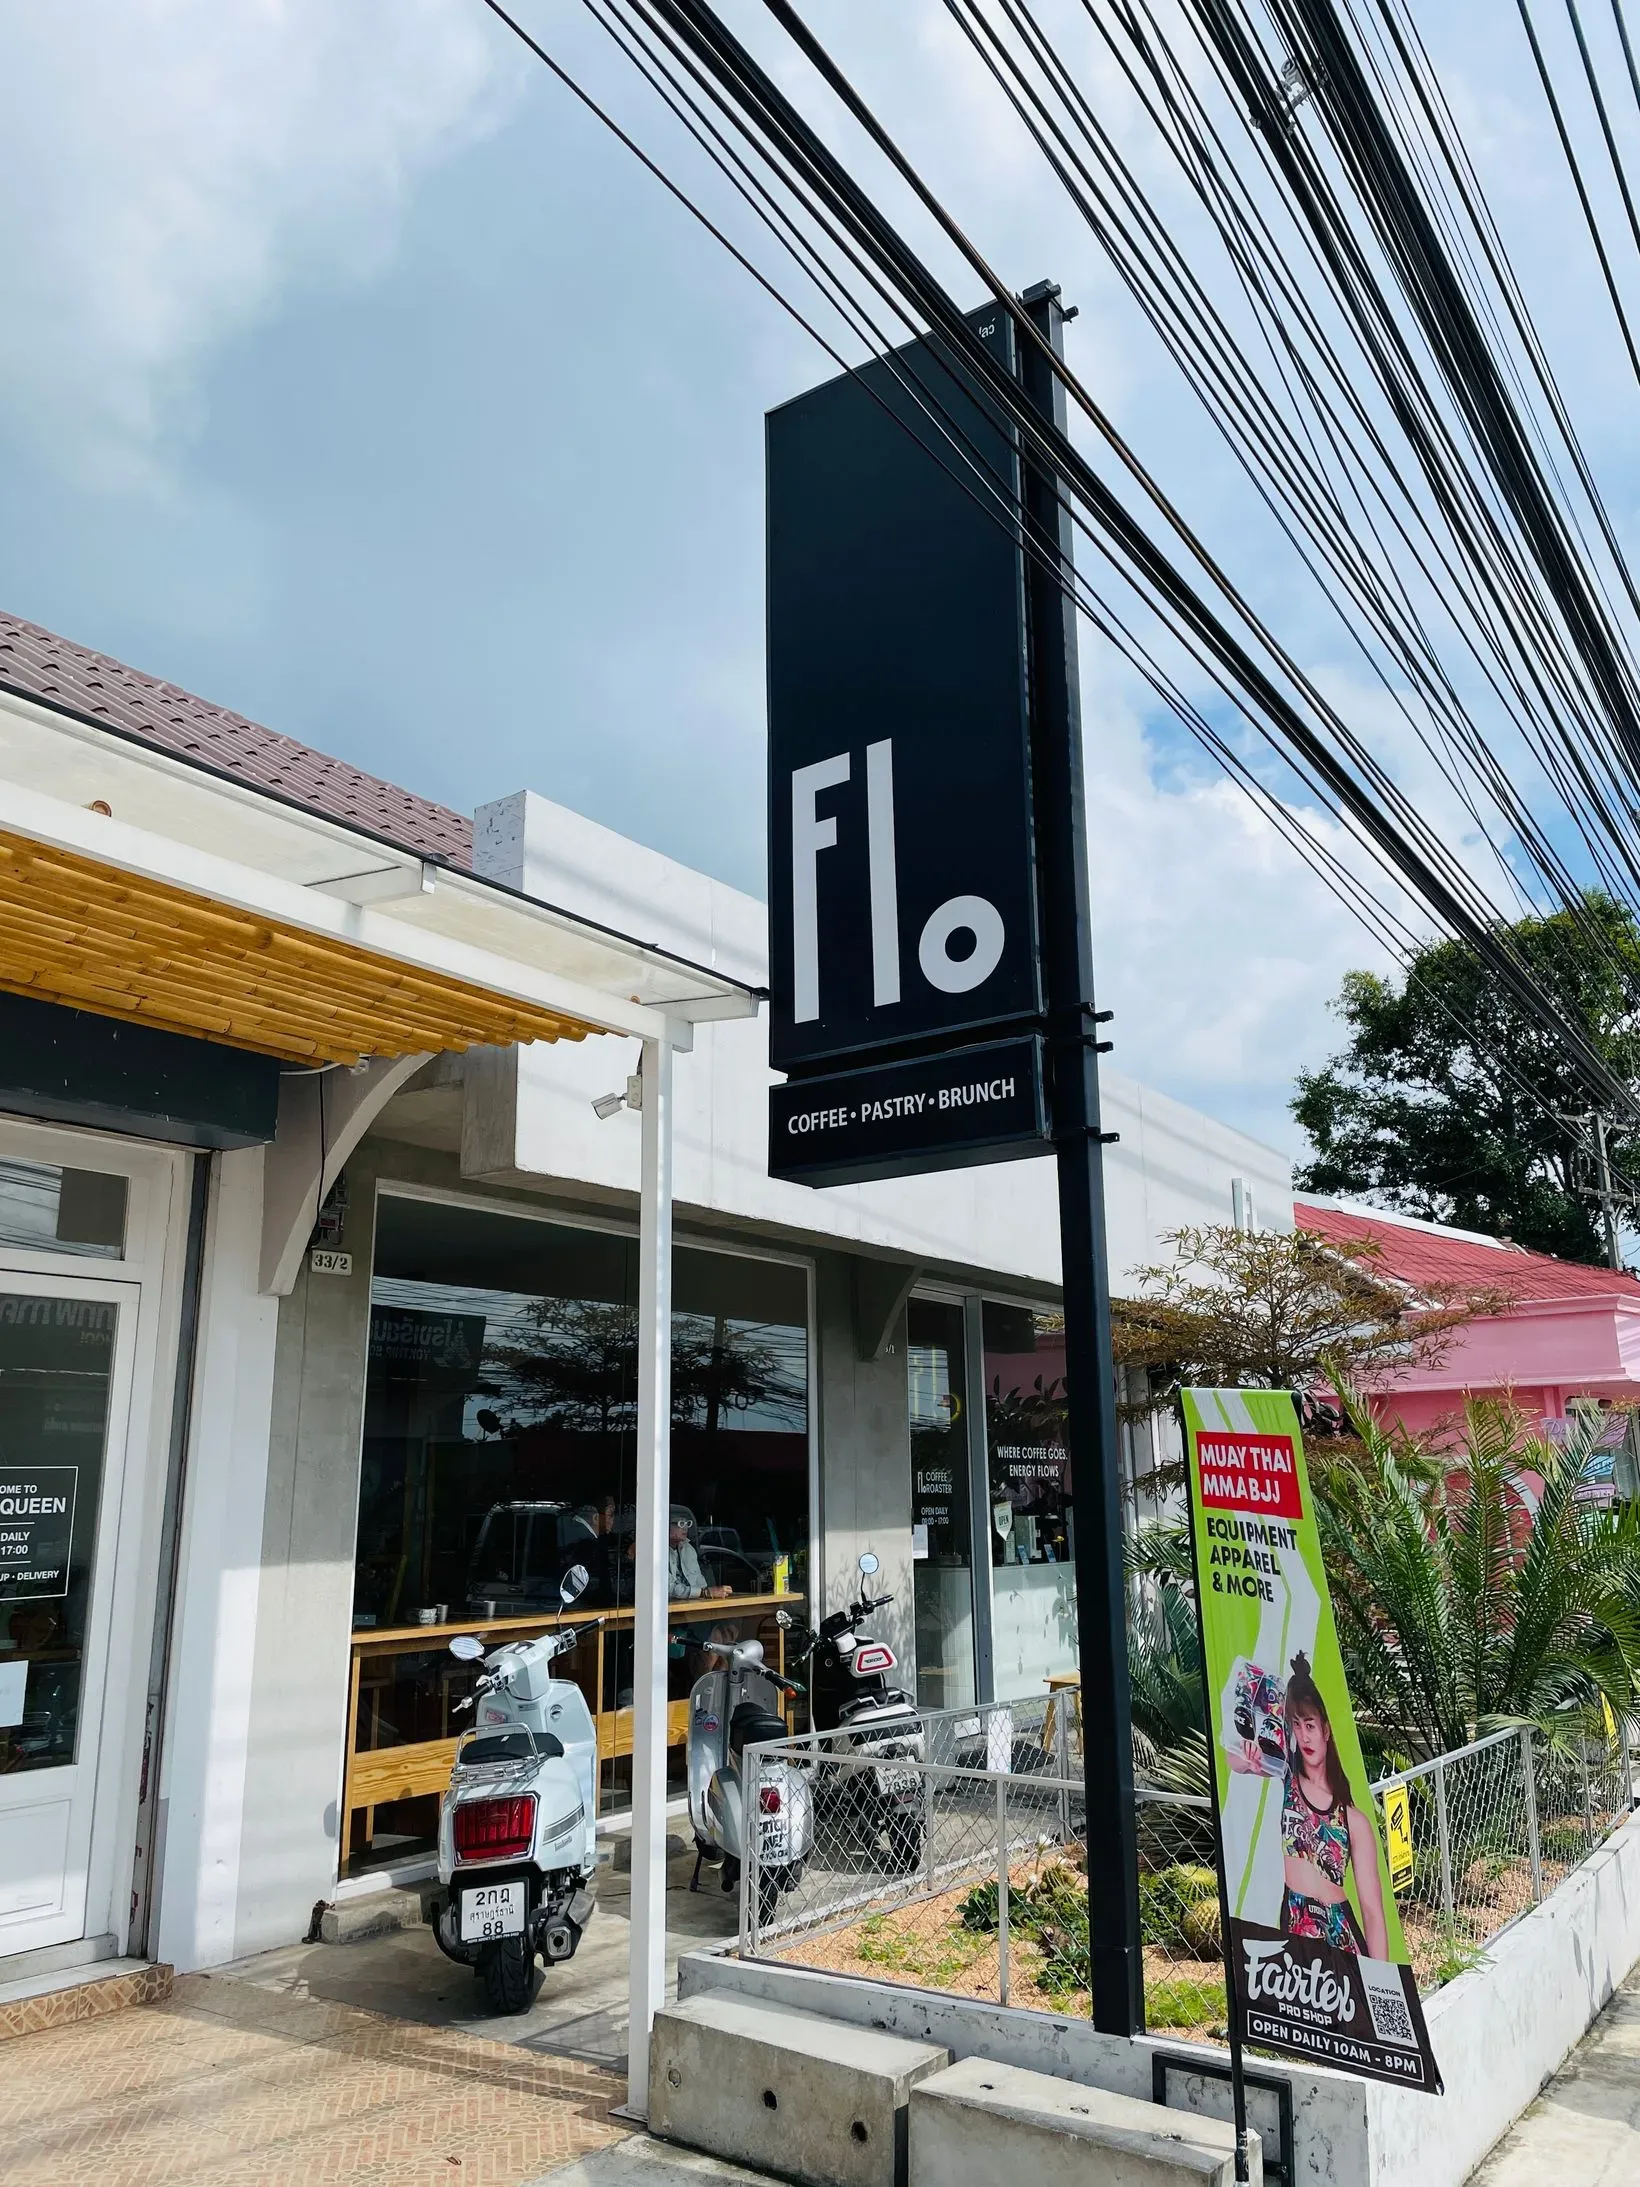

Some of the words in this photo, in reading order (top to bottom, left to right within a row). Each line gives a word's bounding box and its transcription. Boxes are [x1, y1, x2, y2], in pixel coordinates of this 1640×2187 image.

[792, 737, 1005, 1025] Flo
[788, 1107, 848, 1135] COFFEE
[861, 1093, 926, 1123] PASTRY
[938, 1077, 1015, 1110] BRUNCH
[314, 1254, 348, 1270] 33/2
[997, 1446, 1021, 1459] WHERE
[1021, 1447, 1047, 1459] COFFEE
[1200, 1443, 1247, 1469] MUAY
[1250, 1447, 1292, 1473] THAI
[925, 1471, 948, 1482] COFFEE
[1009, 1464, 1036, 1477] ENERGY
[1037, 1465, 1059, 1477] FLOWS
[23, 1485, 37, 1493] TO
[926, 1484, 952, 1494] ROASTER
[0, 1497, 66, 1515] QUEEN
[921, 1507, 934, 1515] OPEN
[935, 1507, 948, 1515] DAILY
[0, 1532, 30, 1542] DAILY
[1206, 1517, 1297, 1551] EQUIPMENT
[0, 1545, 28, 1556] 17:00
[1209, 1545, 1281, 1576] APPAREL
[17, 1570, 59, 1580] DELIVERY
[1212, 1571, 1223, 1593] &
[1227, 1573, 1274, 1603] MORE
[483, 1920, 503, 1936] 88
[1242, 1938, 1356, 2022] Fairtex
[1368, 1984, 1401, 1997] LOCATION
[1278, 2001, 1301, 2018] PRO
[1303, 2009, 1333, 2026] SHOP
[1252, 2019, 1289, 2040] OPEN
[1292, 2029, 1331, 2051] DAILY
[1334, 2041, 1371, 2063] 10AM
[1385, 2055, 1417, 2074] 8PM
